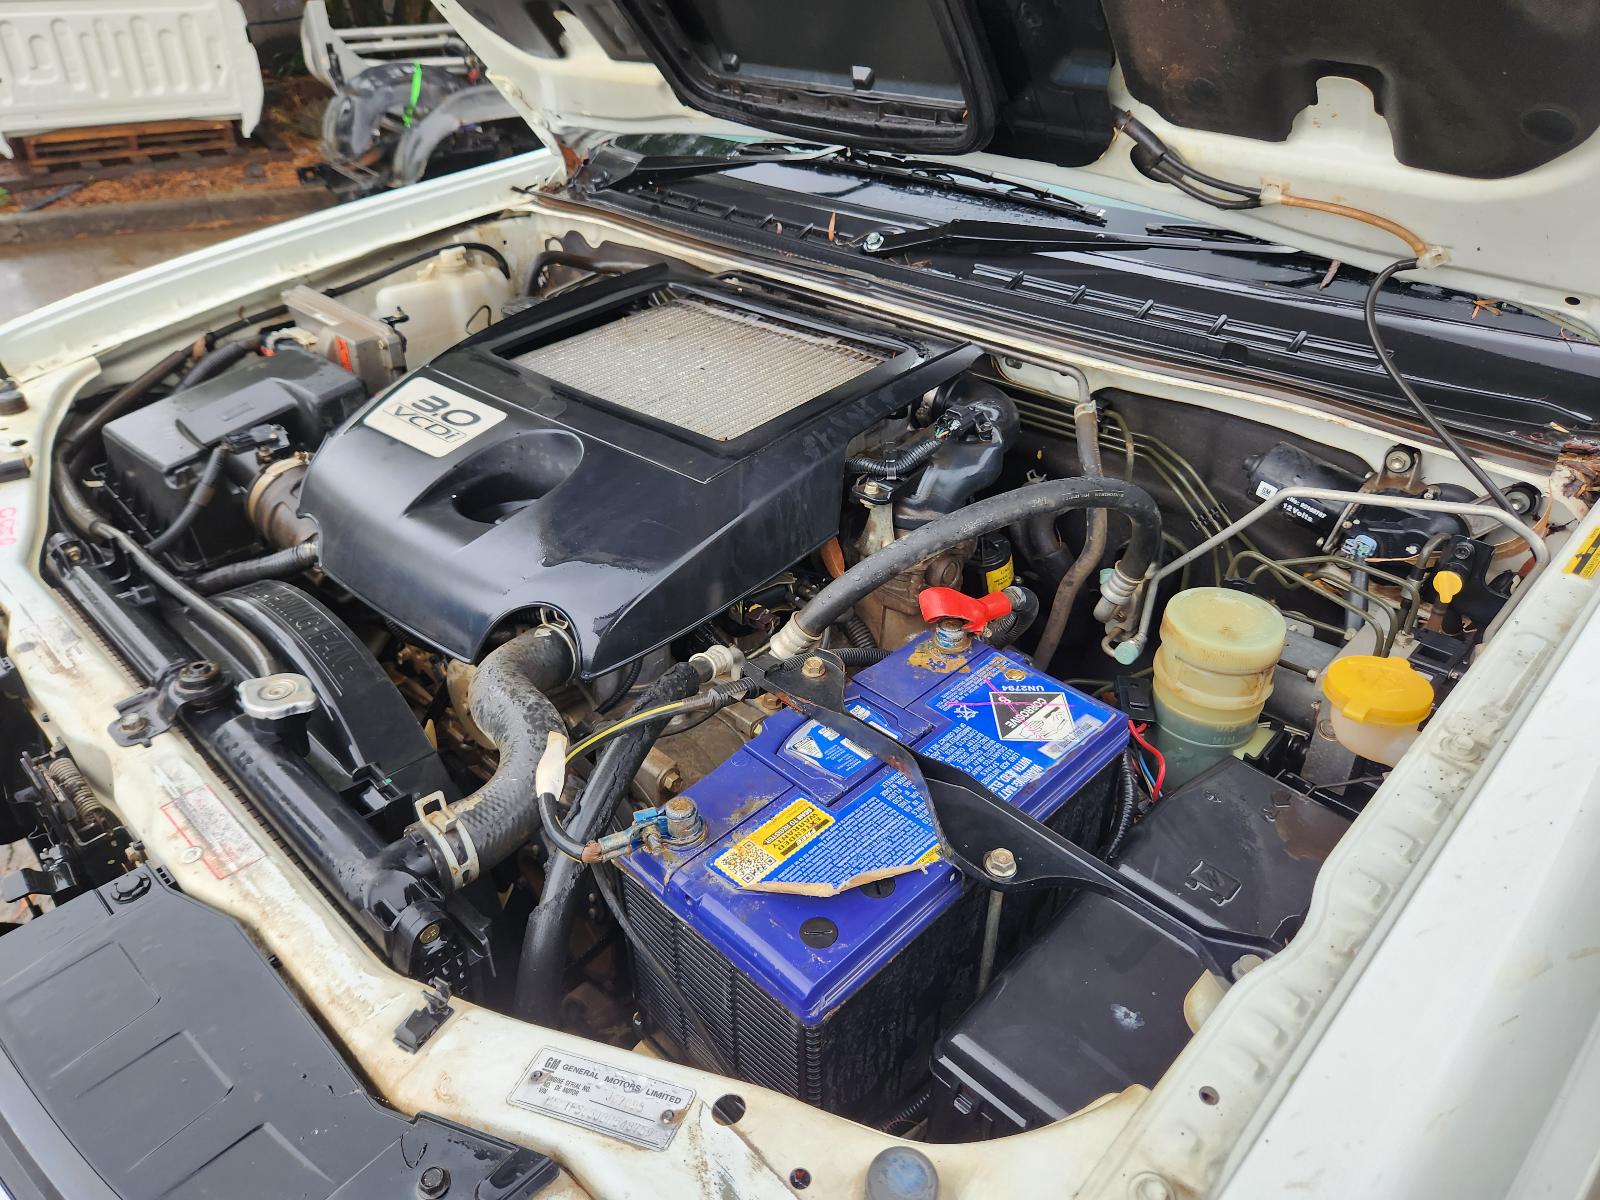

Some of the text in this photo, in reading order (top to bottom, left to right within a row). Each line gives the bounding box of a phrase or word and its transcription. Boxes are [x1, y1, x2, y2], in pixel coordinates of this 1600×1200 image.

[393, 405, 462, 442] VCDi
[412, 396, 482, 427] 3.0
[1001, 684, 1045, 692] UN2794
[1005, 697, 1047, 729] CORROSIVE
[795, 806, 813, 821] SCAN
[764, 823, 790, 844] REGISTER
[772, 812, 817, 848] WARRANTY
[776, 816, 822, 851] EXTENDED
[544, 1056, 562, 1071] GM
[562, 1063, 599, 1080] GENERAL
[604, 1075, 642, 1093] MOTORS
[645, 1089, 682, 1105] LIMITED
